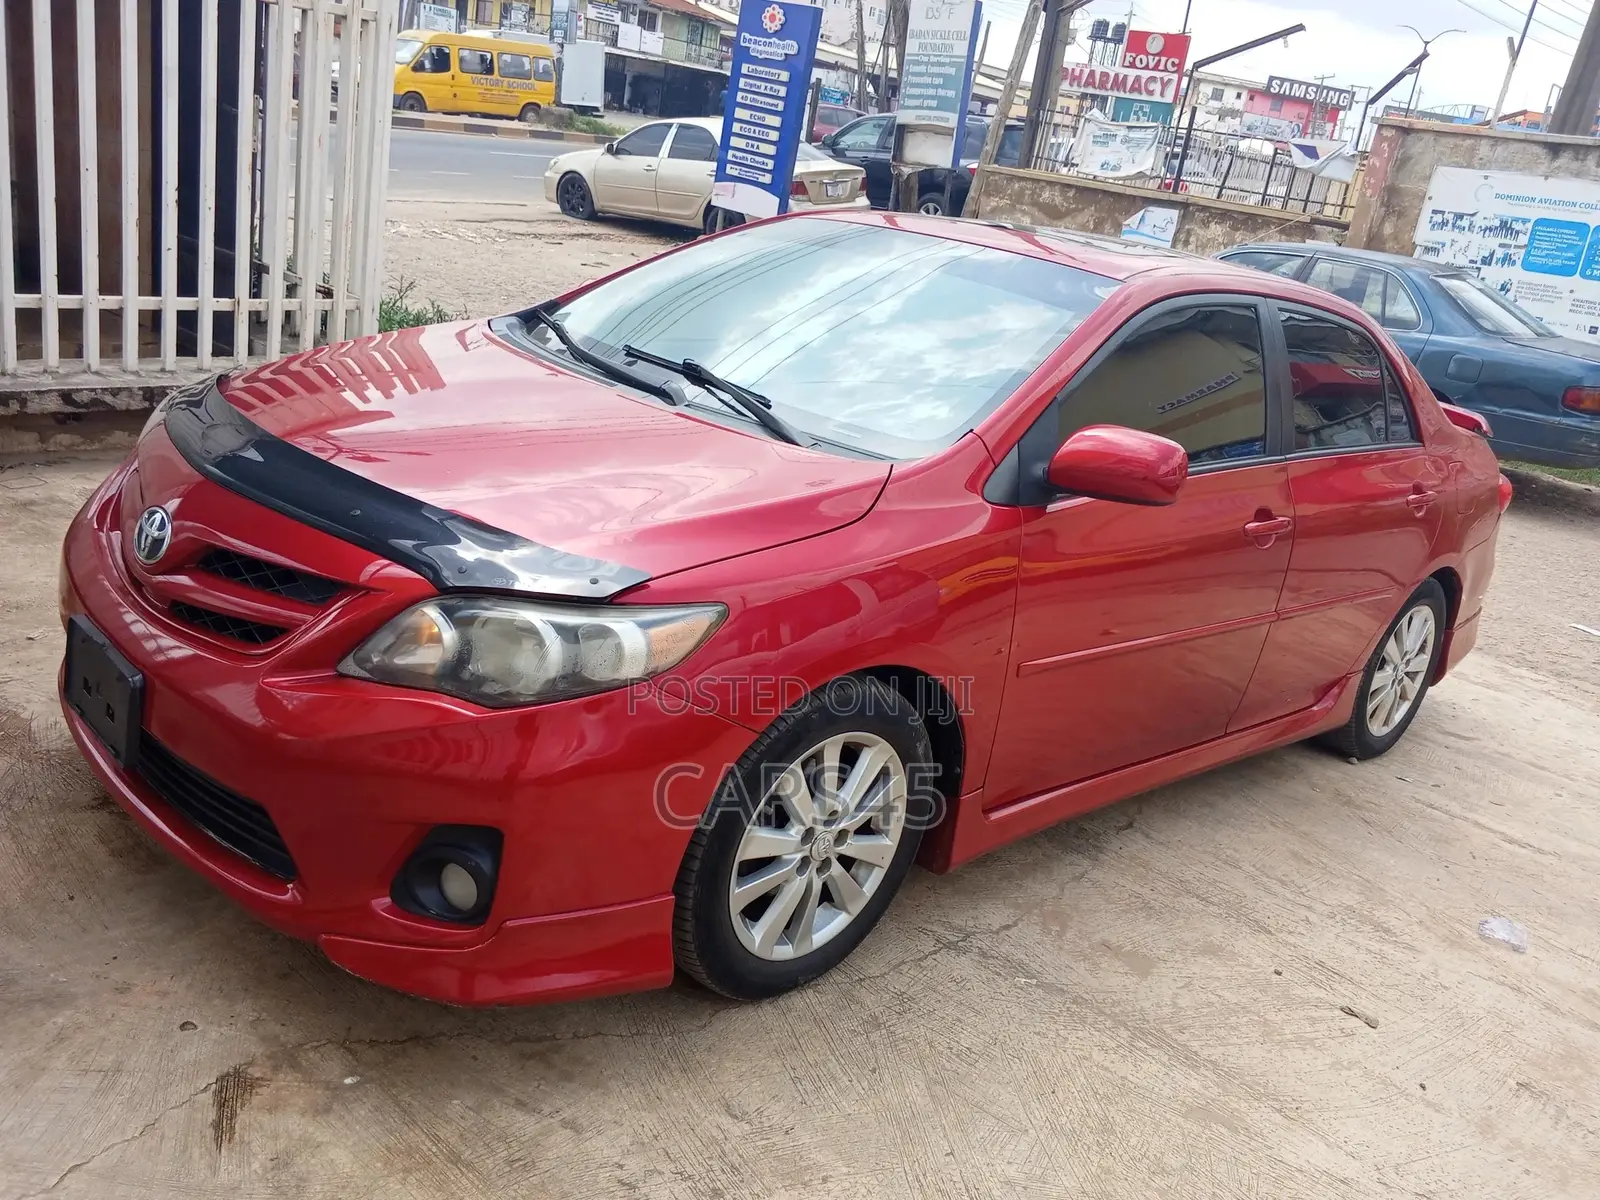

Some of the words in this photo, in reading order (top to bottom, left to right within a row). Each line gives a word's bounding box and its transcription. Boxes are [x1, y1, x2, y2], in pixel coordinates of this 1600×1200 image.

[909, 29, 930, 40] IBADAN
[930, 30, 951, 41] SICKLE
[951, 31, 968, 41] CELL
[750, 47, 783, 59] diagnostics
[917, 42, 955, 54] FOUNDATION
[1123, 53, 1179, 72] FOVIC
[747, 66, 782, 80] Laboratory
[471, 76, 505, 88] VICTORY
[507, 81, 537, 91] SCHOOL
[743, 81, 762, 91] Digital
[763, 85, 781, 95] X-Ray
[932, 77, 944, 85] care
[1060, 66, 1174, 98] PHARMACY
[1270, 79, 1350, 107] SAMSUNG
[749, 97, 780, 109] Ultrasound
[749, 113, 766, 122] ECHO
[739, 125, 752, 134] ECG
[731, 152, 749, 163] Health
[749, 157, 769, 167] Checks
[1494, 192, 1537, 204] DOMINION
[1537, 197, 1578, 209] AVIATION
[1578, 202, 1600, 211] COLL
